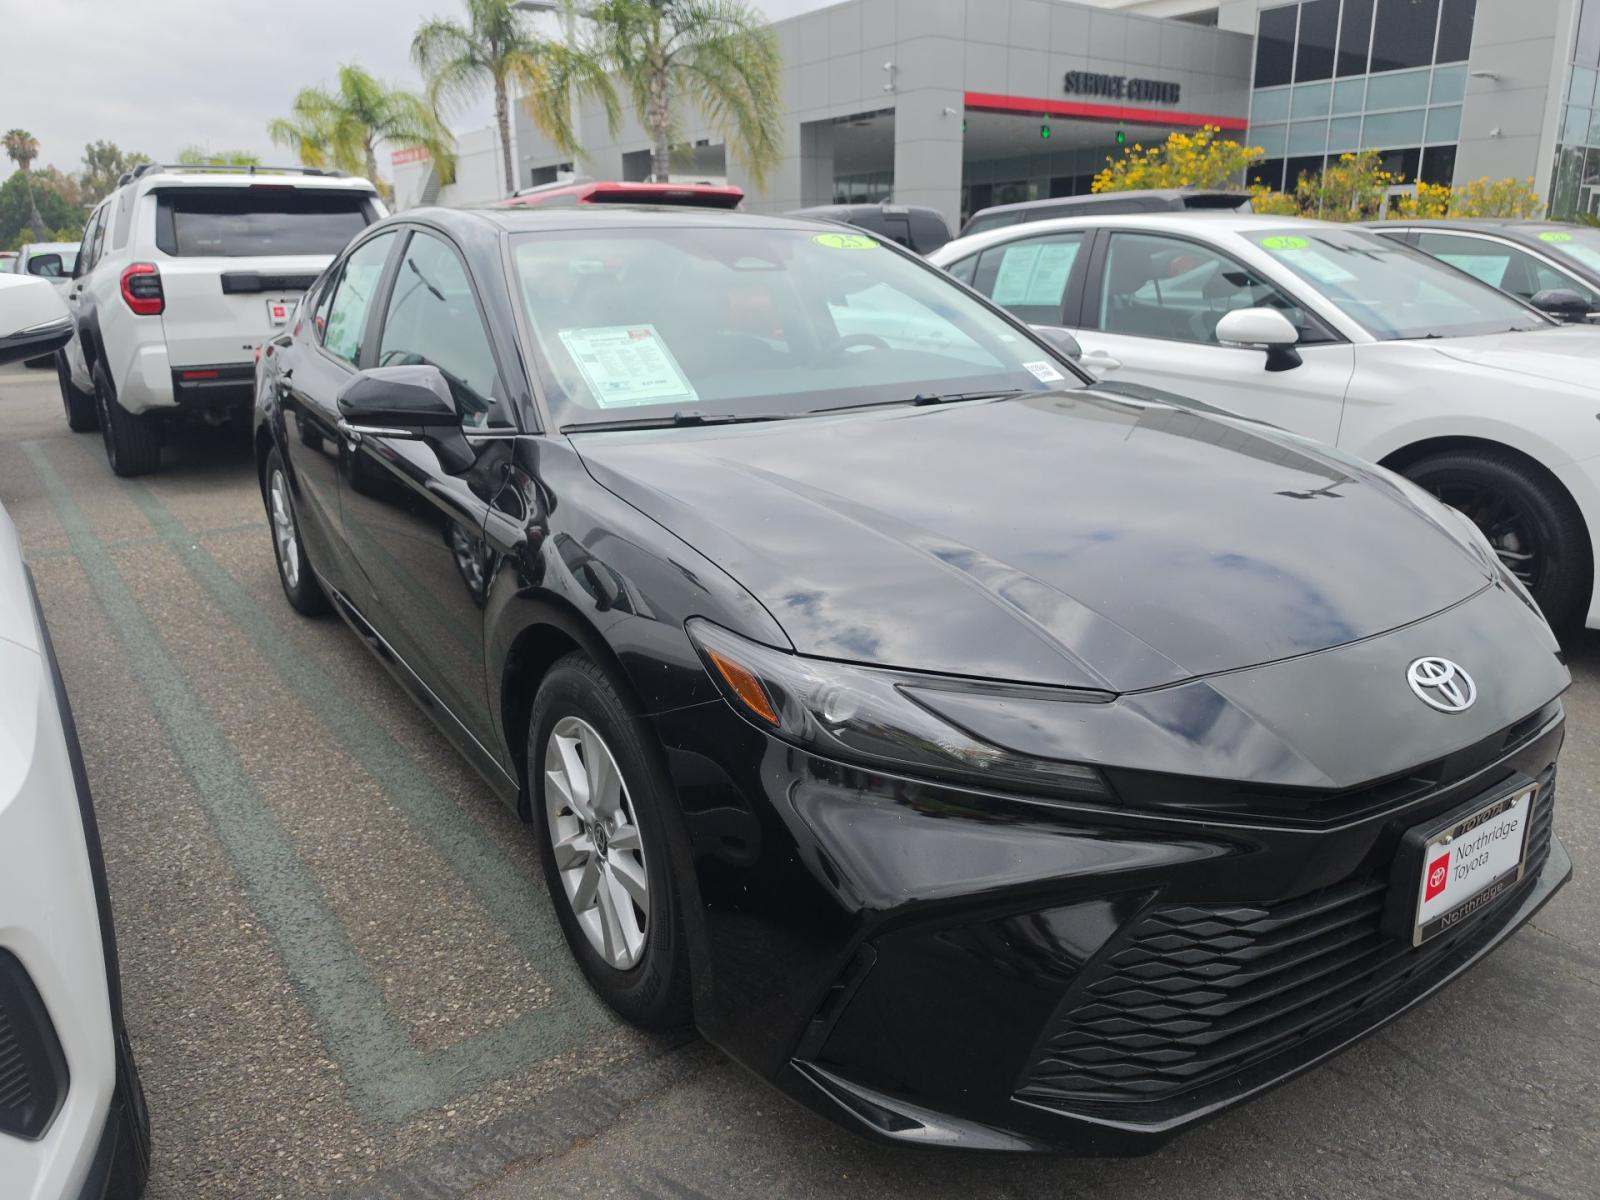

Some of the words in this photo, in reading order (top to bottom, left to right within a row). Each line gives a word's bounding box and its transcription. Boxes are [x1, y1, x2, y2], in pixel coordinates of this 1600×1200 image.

[1064, 70, 1127, 99] SERVICE
[1127, 78, 1181, 104] CENTER
[1455, 819, 1518, 862] Northridge
[1453, 851, 1489, 882] Toyota
[1441, 882, 1504, 929] Northridge
